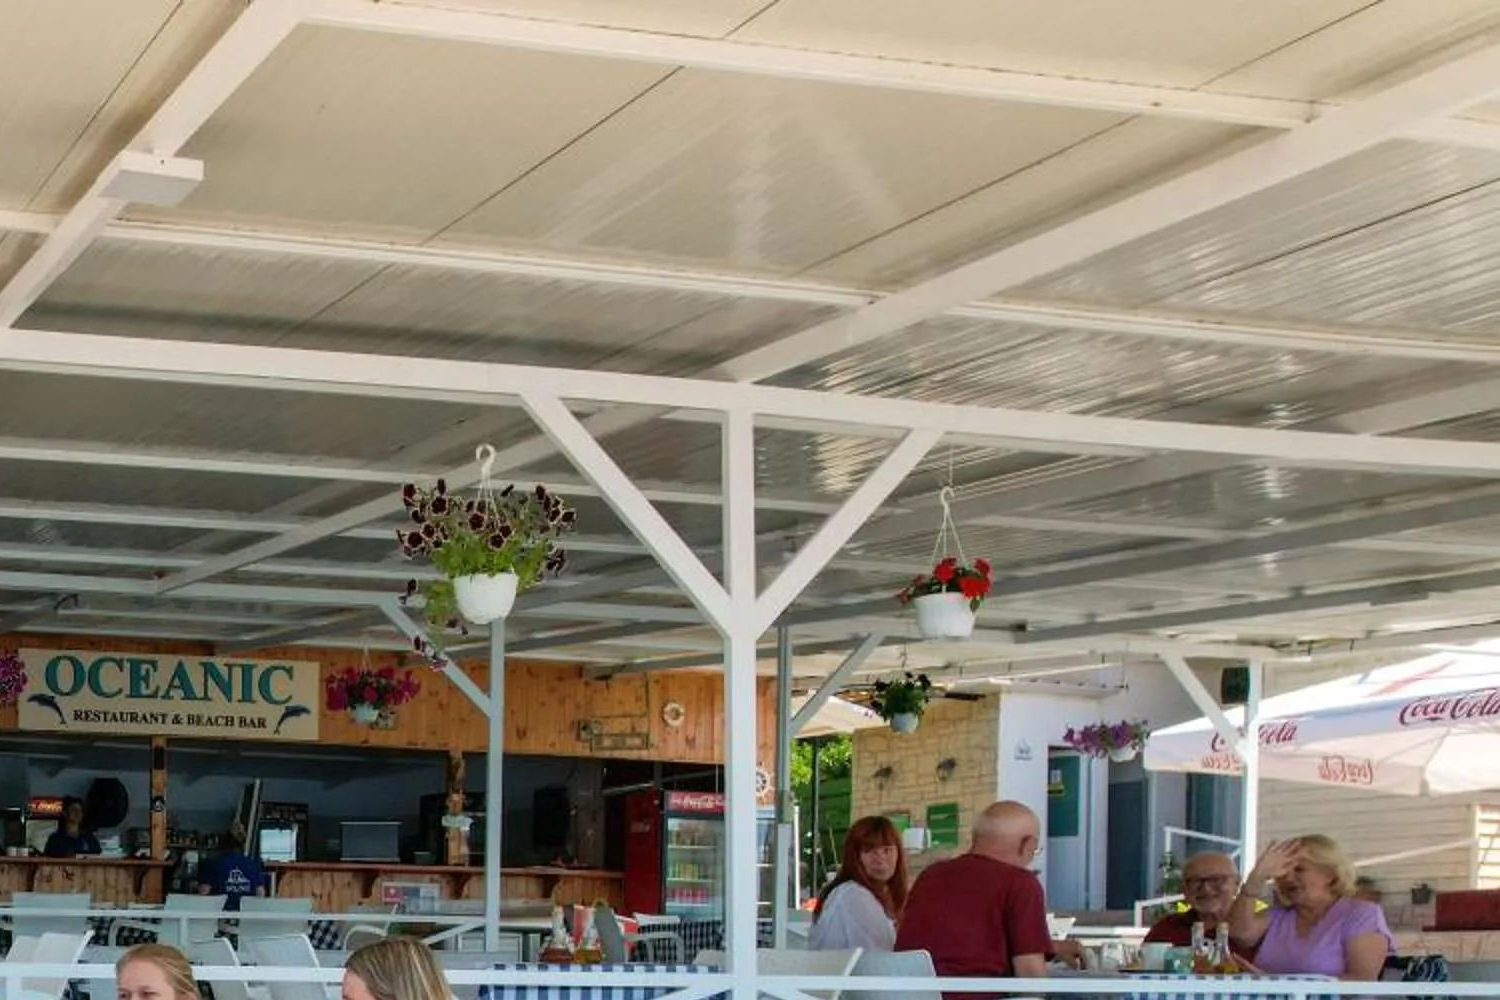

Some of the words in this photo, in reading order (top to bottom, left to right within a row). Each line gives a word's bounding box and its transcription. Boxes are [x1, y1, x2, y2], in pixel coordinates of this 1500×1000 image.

[45, 655, 293, 705] OCEANIC
[73, 709, 168, 724] RESTAURANT
[172, 714, 183, 725] &
[187, 713, 235, 727] BEACH
[238, 717, 267, 729] BAR
